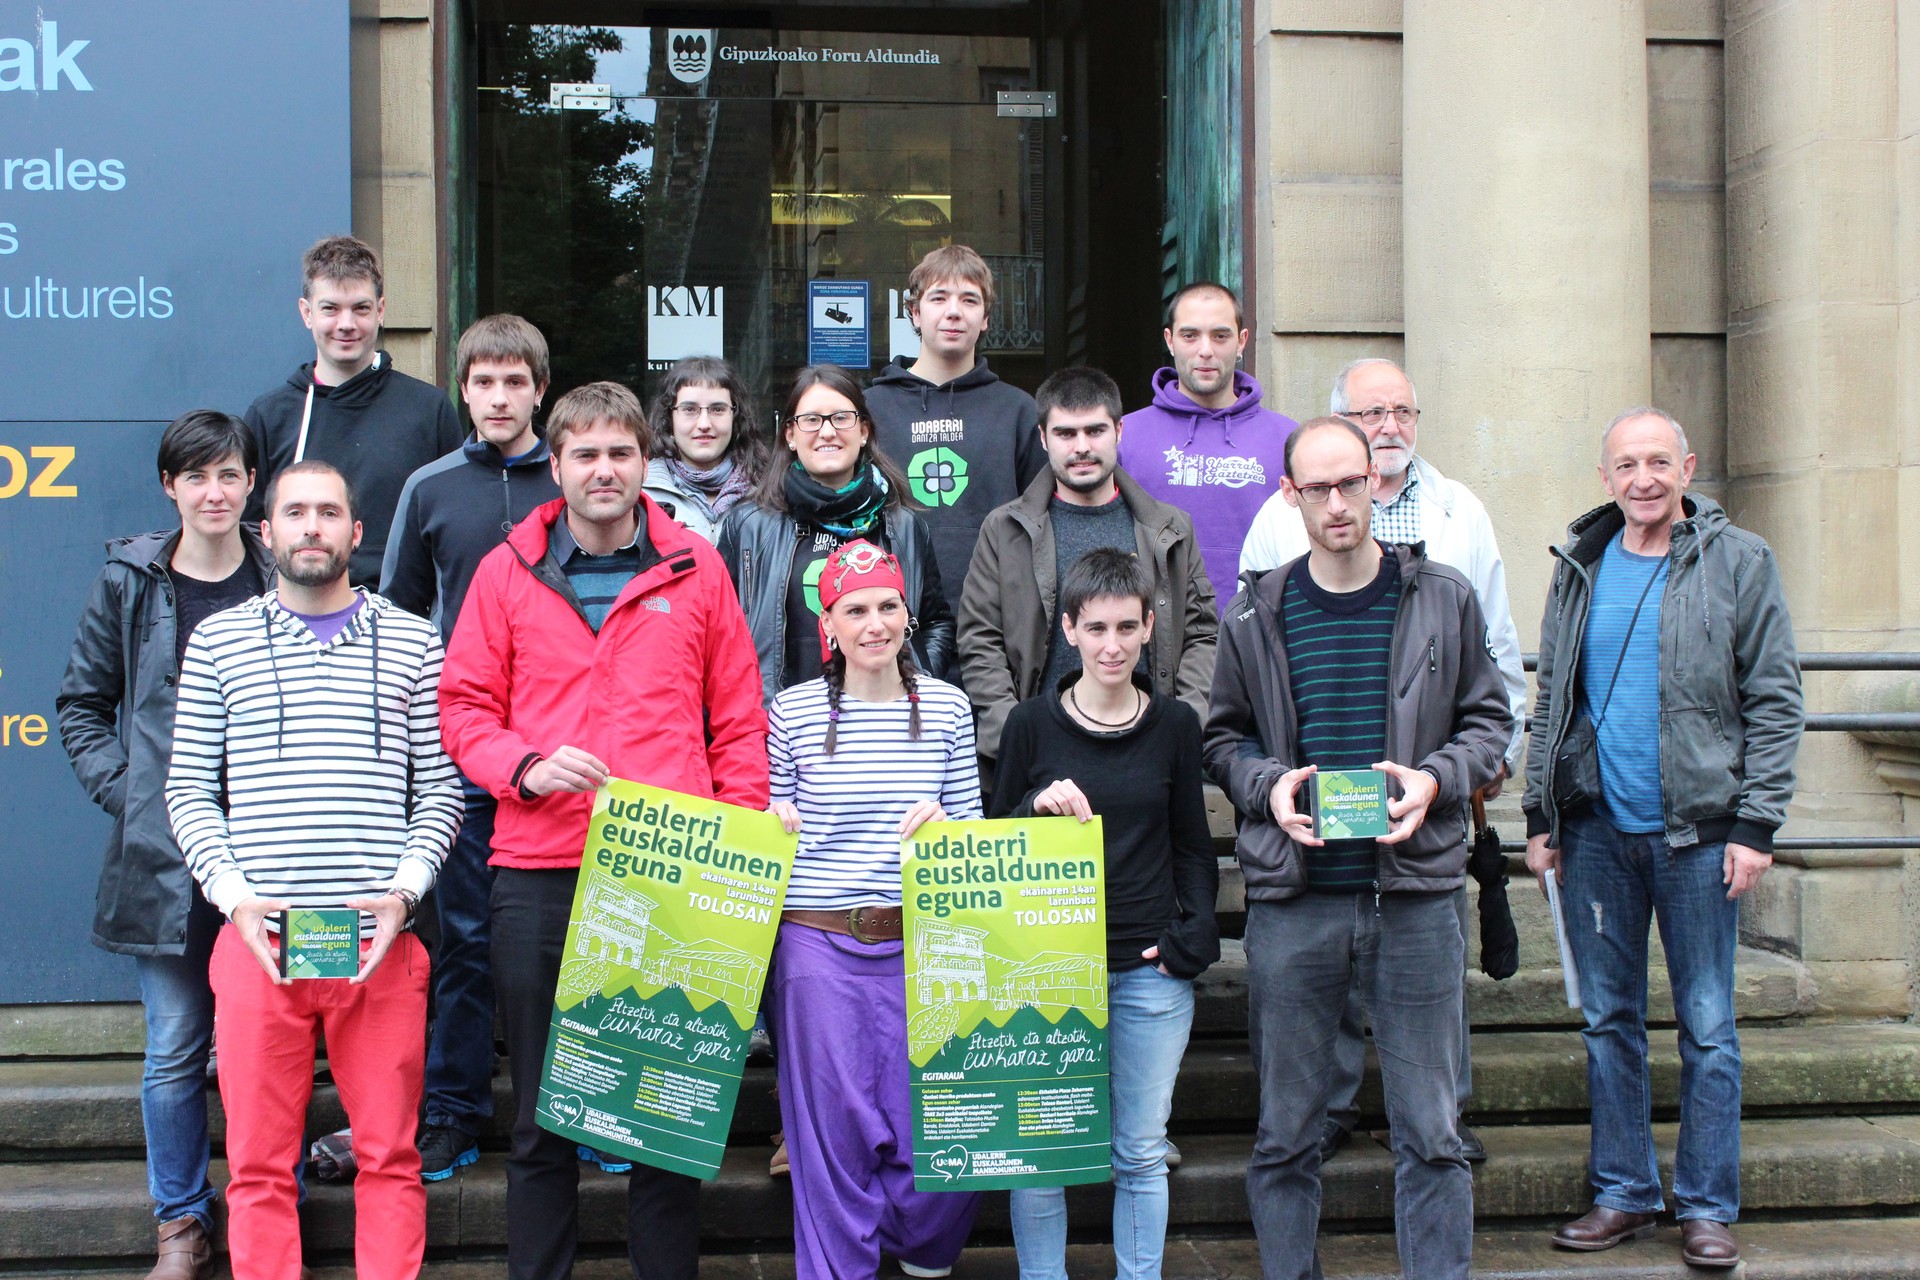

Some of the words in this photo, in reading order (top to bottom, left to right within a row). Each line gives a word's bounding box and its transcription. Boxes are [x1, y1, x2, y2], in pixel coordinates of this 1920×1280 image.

[719, 46, 818, 64] Gipuzkoako
[821, 48, 862, 63] Foru
[864, 49, 940, 65] Aldundia
[4, 148, 126, 191] rales
[4, 276, 174, 319] ulturels
[652, 284, 719, 317] KM
[912, 419, 963, 434] UDABERRI
[912, 433, 938, 443] DANTZA
[940, 432, 963, 442] TALDEA
[1206, 459, 1263, 473] Ibarrako
[1205, 467, 1265, 484] Gaztetxea
[1325, 793, 1379, 802] euskaldunen
[1342, 784, 1378, 793] udalerri
[1351, 801, 1379, 810] eguna
[608, 797, 722, 841] udalerri
[602, 823, 782, 881] euskaldunen
[915, 831, 1027, 861] udalerri
[596, 848, 682, 884] eguna
[915, 857, 1095, 886] euskaldunen
[700, 871, 750, 891] ekainaren
[751, 883, 778, 896] 14an
[1020, 886, 1069, 897] ekainaren
[1071, 885, 1096, 894] 14an
[726, 888, 775, 907] larunbata
[916, 889, 1002, 918] eguna
[1048, 895, 1096, 907] larunbata
[688, 892, 771, 925] TOLOSAN
[1014, 908, 1096, 926] TOLOSAN
[294, 932, 351, 940] euskaldunen
[313, 924, 350, 932] udalerri
[322, 941, 351, 950] eguna
[560, 1017, 599, 1037] EGITARAUA
[687, 1040, 742, 1063] gara!
[1056, 1043, 1102, 1075] gara!
[922, 1071, 964, 1081] EGITARAUA
[585, 1108, 618, 1124] UDALERRI
[583, 1122, 643, 1147] MANKOMUNITATEA
[584, 1115, 632, 1136] EUSKALDUNEN
[972, 1152, 1007, 1160] UDALERRI
[972, 1158, 1023, 1167] EUSKALDUNEN
[972, 1165, 1038, 1175] MANKOMUNITATEA
